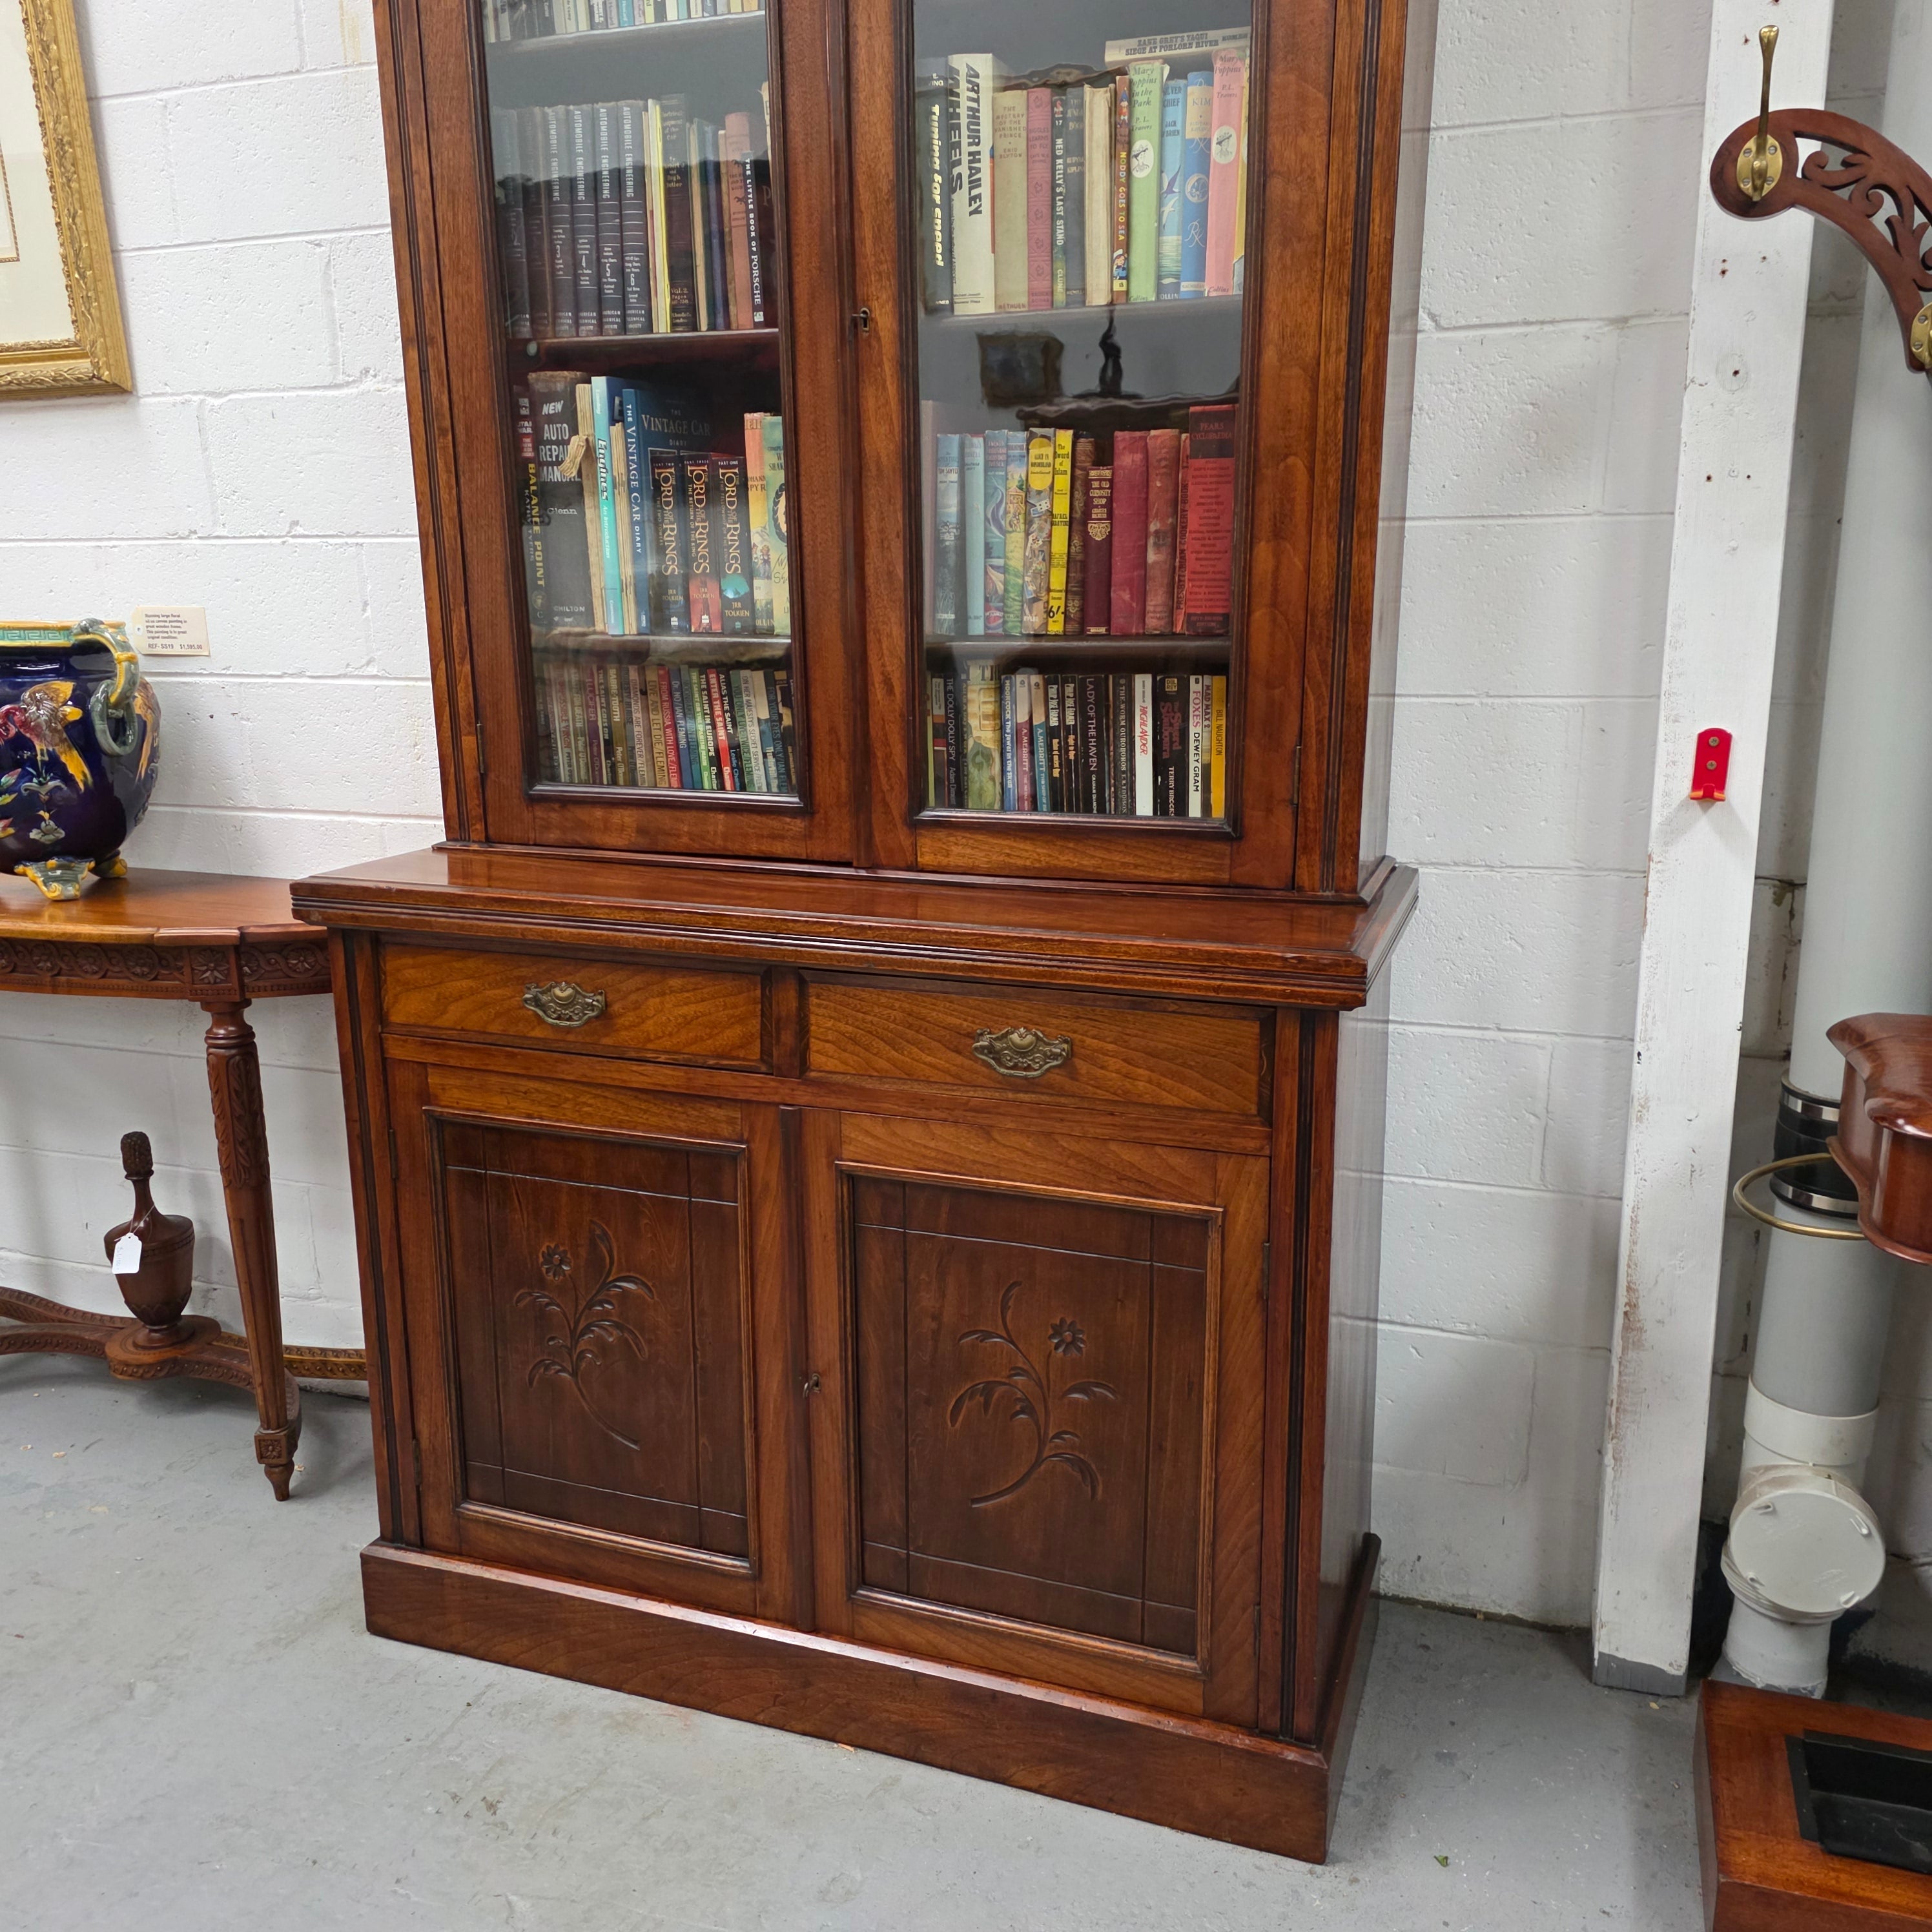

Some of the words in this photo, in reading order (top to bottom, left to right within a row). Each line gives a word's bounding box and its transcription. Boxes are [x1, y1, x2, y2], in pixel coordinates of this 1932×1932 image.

[1125, 46, 1147, 56] SIEGE
[1148, 45, 1158, 54] AT
[1159, 43, 1193, 52] FORLORN
[1195, 39, 1219, 48] RIVER
[1138, 38, 1157, 46] ZANE
[1159, 36, 1185, 45] GREY'S
[1186, 33, 1208, 41] YAQUI
[1133, 67, 1155, 76] Mary
[1214, 66, 1241, 77] Poppins
[1218, 54, 1239, 65] Mary
[965, 63, 981, 147] ARTHUR
[1132, 88, 1139, 98] in
[1141, 88, 1153, 97] the
[1133, 98, 1152, 108] Park
[1192, 98, 1211, 107] KIM
[574, 110, 583, 153] AUTOMOBILE
[599, 108, 608, 150] AUTOMOBILE
[623, 107, 632, 150] AUTOMOBILE
[929, 104, 941, 170] Tuning
[948, 65, 963, 196] WHEELS
[576, 157, 585, 200] ENGINEERING
[601, 156, 610, 198] ENGINEERING
[625, 154, 634, 198] ENGINEERING
[967, 151, 983, 218] HAILEY
[1056, 159, 1064, 193] KELLY'S
[1056, 196, 1064, 216] LAST
[1118, 212, 1125, 223] TO
[1056, 220, 1065, 245] STAND
[752, 241, 756, 251] OF
[752, 255, 761, 304] PORSCHE
[542, 400, 564, 415] NEW
[544, 424, 569, 440] AUTO
[641, 415, 688, 434] VINTAGE
[691, 420, 711, 437] CAR
[597, 438, 610, 500] Engines
[626, 426, 639, 489] VINTAGE
[655, 467, 675, 509] LORD
[688, 465, 708, 507] LORD
[719, 467, 739, 509] LORD
[630, 493, 641, 520] CAR
[528, 463, 540, 534] BALANCE
[535, 541, 545, 588] POINT
[662, 523, 678, 575] RINGS
[694, 520, 710, 573] RINGS
[725, 522, 741, 573] RINGS
[610, 669, 620, 721] SABRE-TOOTH
[648, 681, 657, 696] LIVE
[1065, 683, 1074, 697] PHILIP
[1086, 678, 1095, 703] LADY
[650, 699, 659, 715] AND
[719, 674, 728, 695] ALIAS
[725, 713, 734, 734] SAINT
[736, 701, 745, 719] ONLY
[745, 699, 755, 728] MAJESTY'S
[768, 702, 778, 720] YOUR
[1066, 698, 1074, 708] JOSE
[1087, 705, 1095, 717] OF
[633, 715, 642, 728] ARE
[652, 718, 661, 731] LET
[705, 715, 710, 723] IN
[717, 717, 725, 740] SAINT
[1049, 710, 1059, 726] FARMER
[1066, 708, 1075, 725] FARMER
[1087, 718, 1096, 737] THE
[677, 720, 686, 748] FLEMING
[706, 726, 715, 757] EUROPE
[748, 729, 758, 749] SECRET
[772, 722, 780, 738] EYES
[1137, 705, 1150, 755] HIGHLANDER
[1088, 739, 1097, 771] HAVEN
